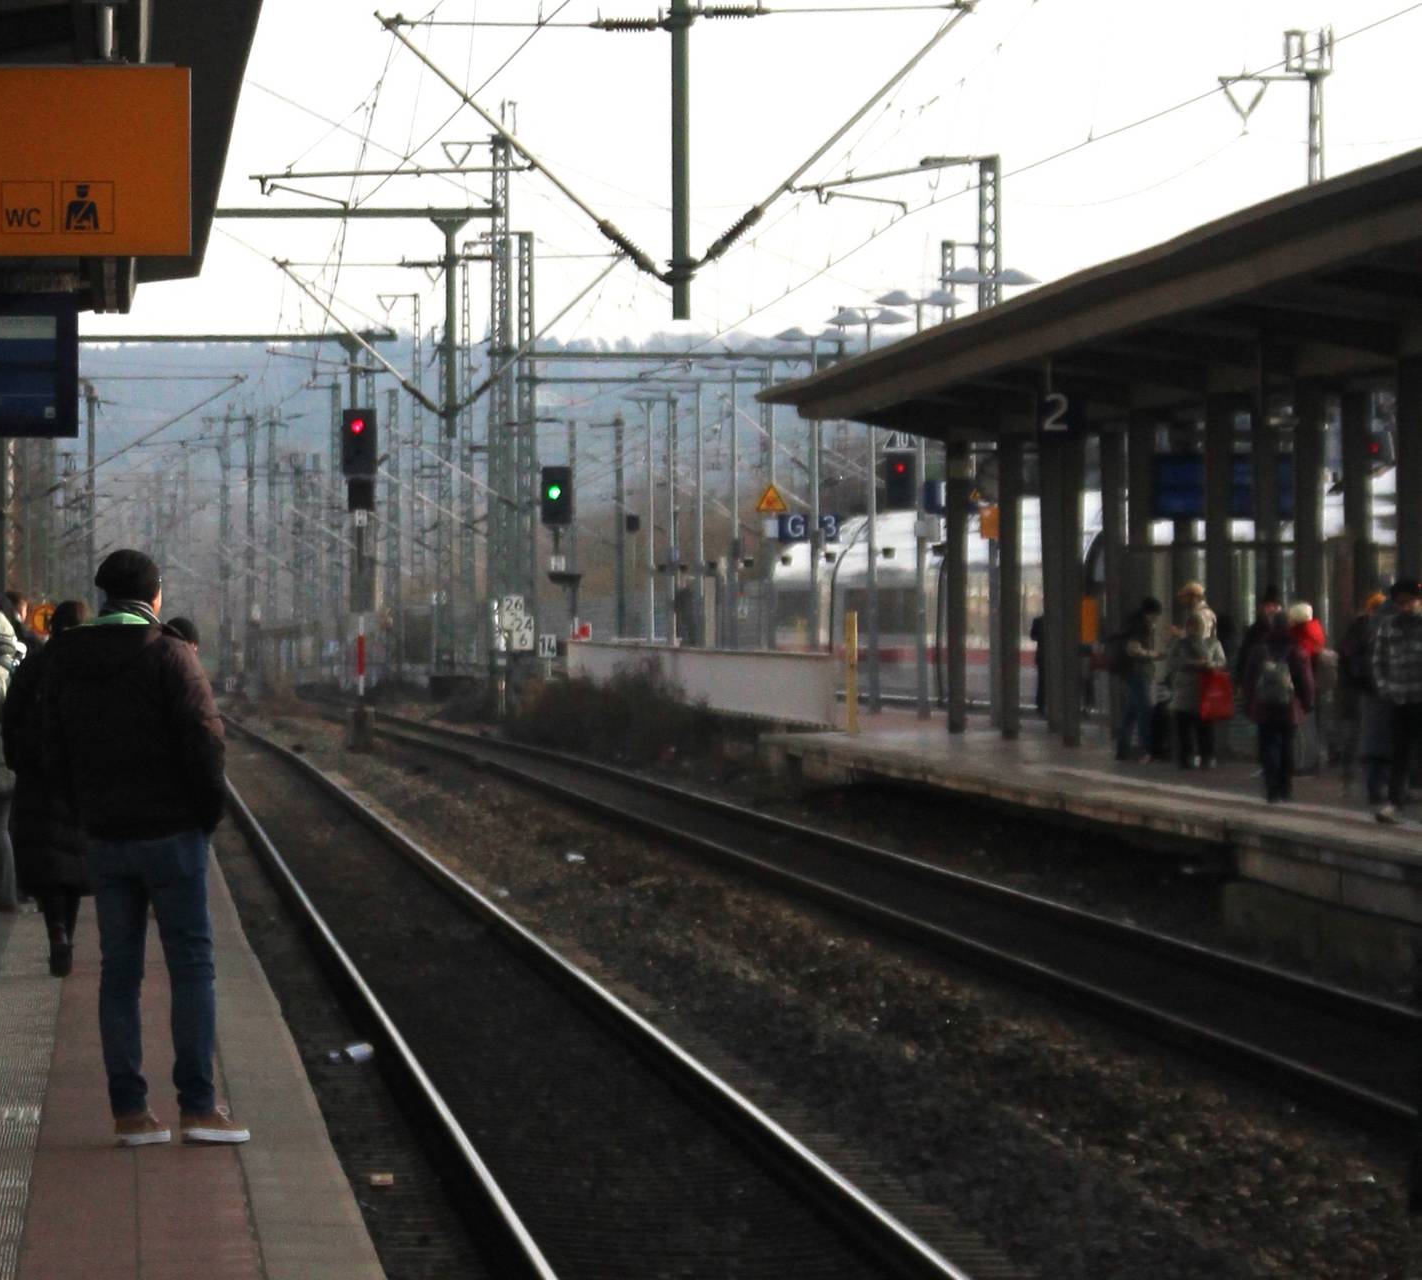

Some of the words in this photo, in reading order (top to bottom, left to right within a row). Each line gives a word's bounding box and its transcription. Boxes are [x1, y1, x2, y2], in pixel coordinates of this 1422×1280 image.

[5, 208, 42, 228] WC
[1043, 392, 1069, 432] 2
[787, 515, 805, 538] G
[823, 515, 837, 538] 3
[505, 598, 523, 612] 26
[519, 633, 528, 647] 6
[539, 637, 556, 656] 14
